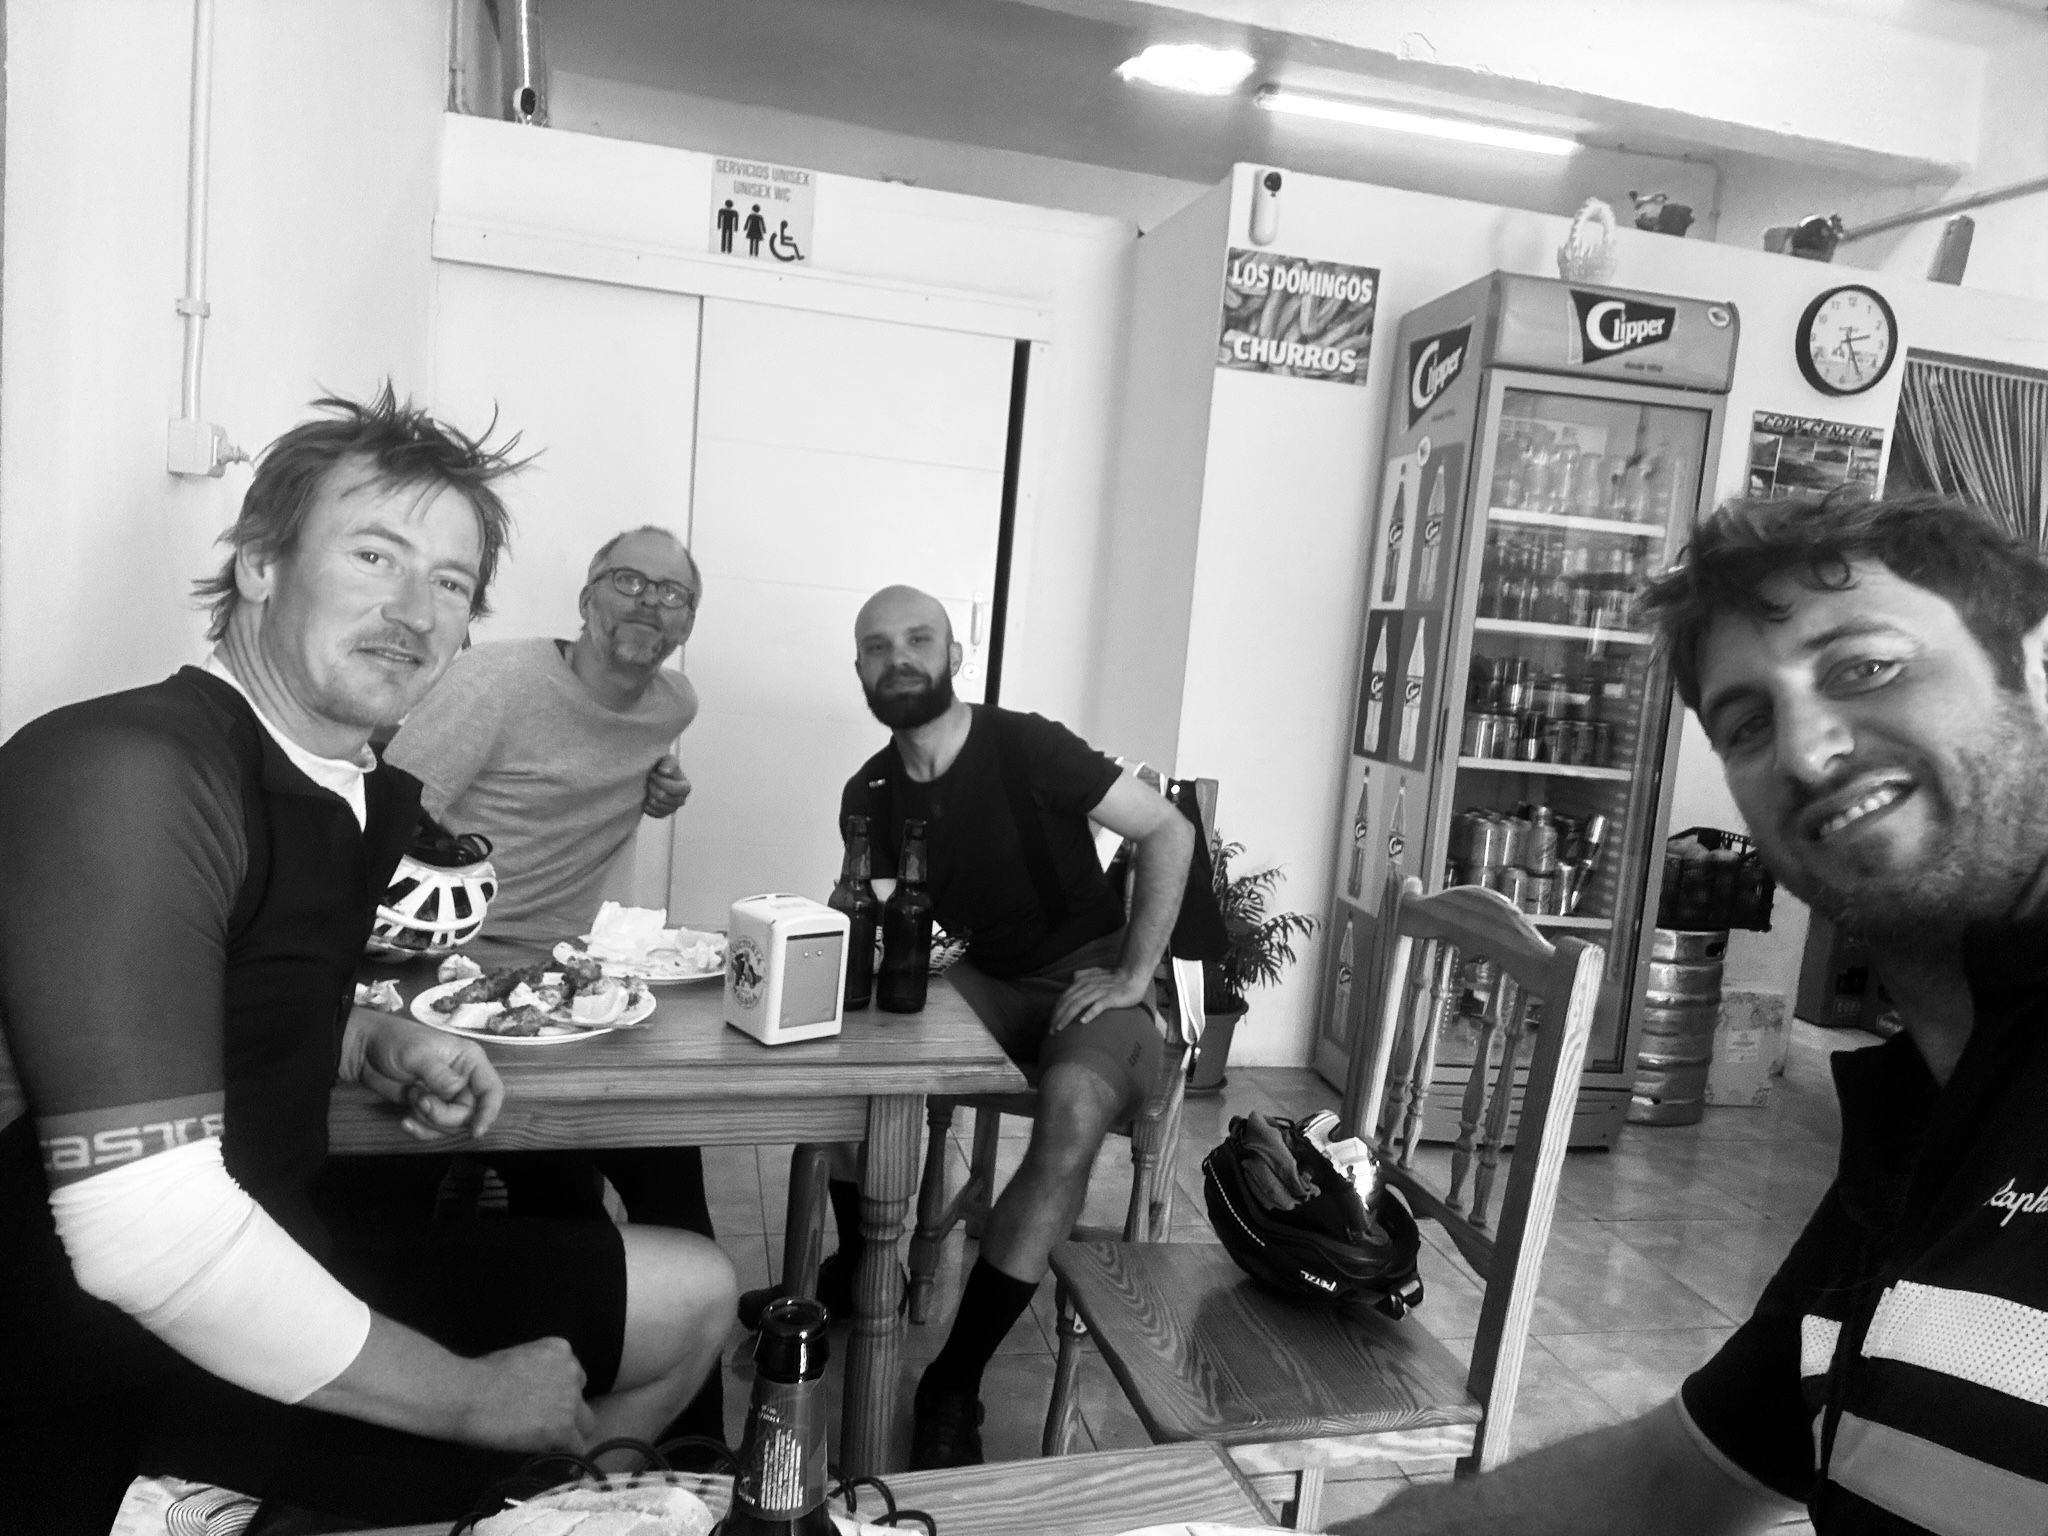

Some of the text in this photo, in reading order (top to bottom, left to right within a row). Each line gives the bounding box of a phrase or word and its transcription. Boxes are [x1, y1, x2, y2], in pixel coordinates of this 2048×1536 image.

[715, 159, 810, 185] SERVICIOS UNISEX
[733, 180, 791, 202] UNISEX WC
[1231, 261, 1374, 304] LOS DOMINGOS
[1586, 301, 1666, 350] Clipper
[1233, 334, 1358, 374] CHURROS
[1411, 339, 1462, 409] Clipper
